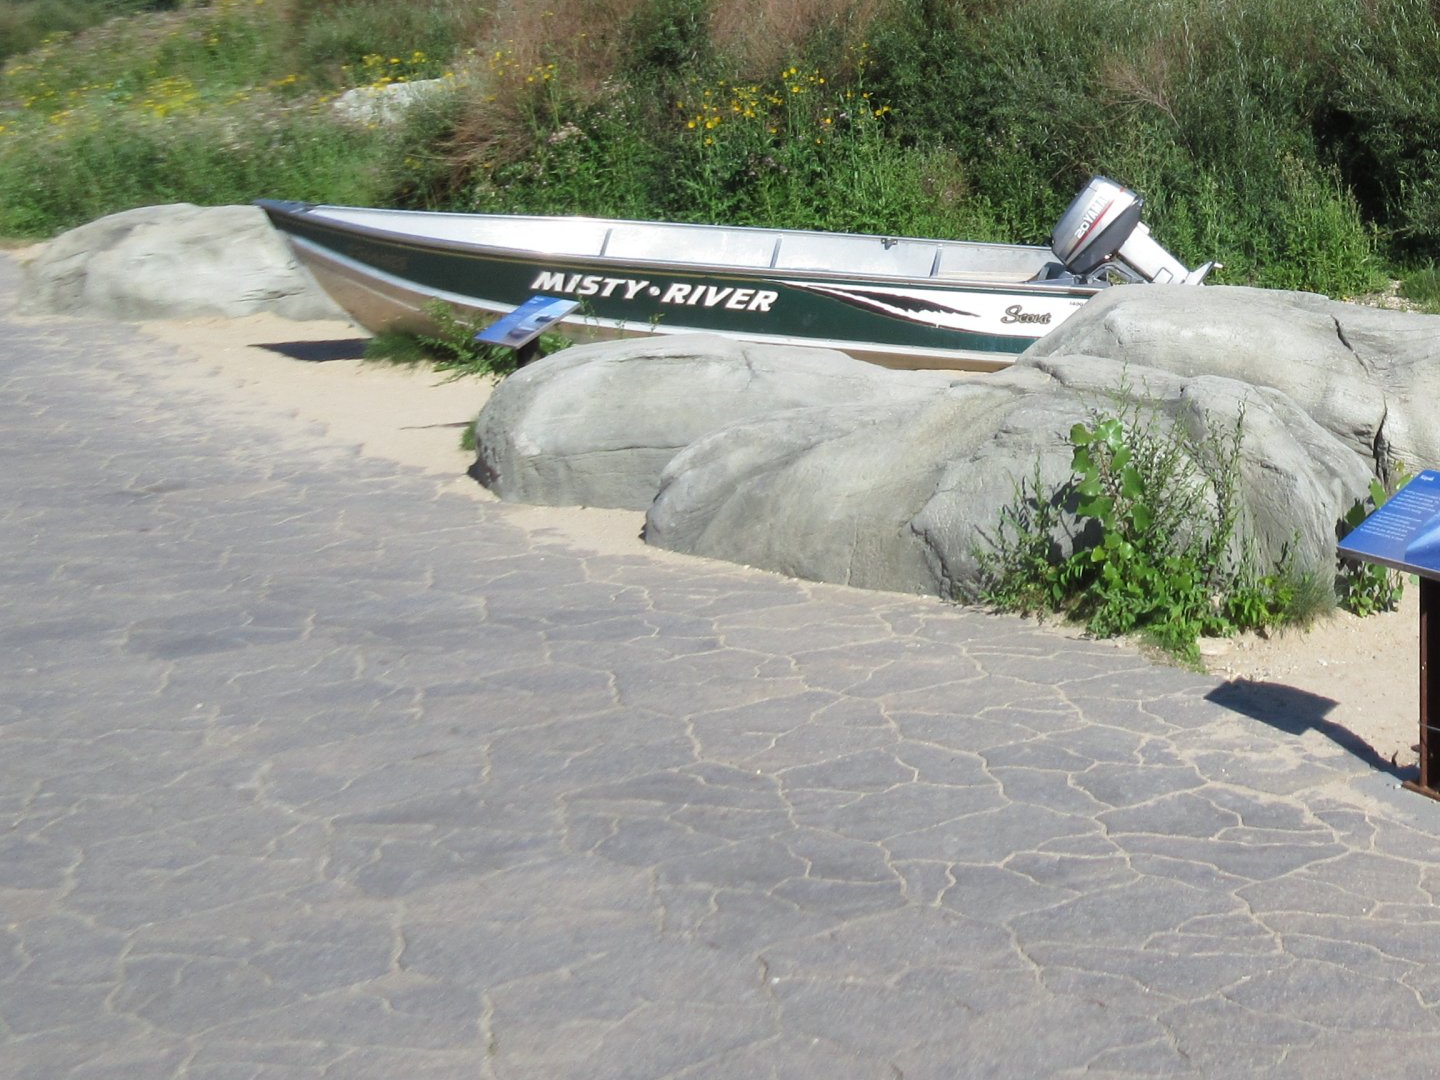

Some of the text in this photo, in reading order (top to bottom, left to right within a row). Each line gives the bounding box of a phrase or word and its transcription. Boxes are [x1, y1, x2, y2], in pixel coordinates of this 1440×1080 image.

[1074, 221, 1090, 239] 20
[530, 271, 780, 313] MISTY RIVER
[1000, 304, 1052, 325] Scout
